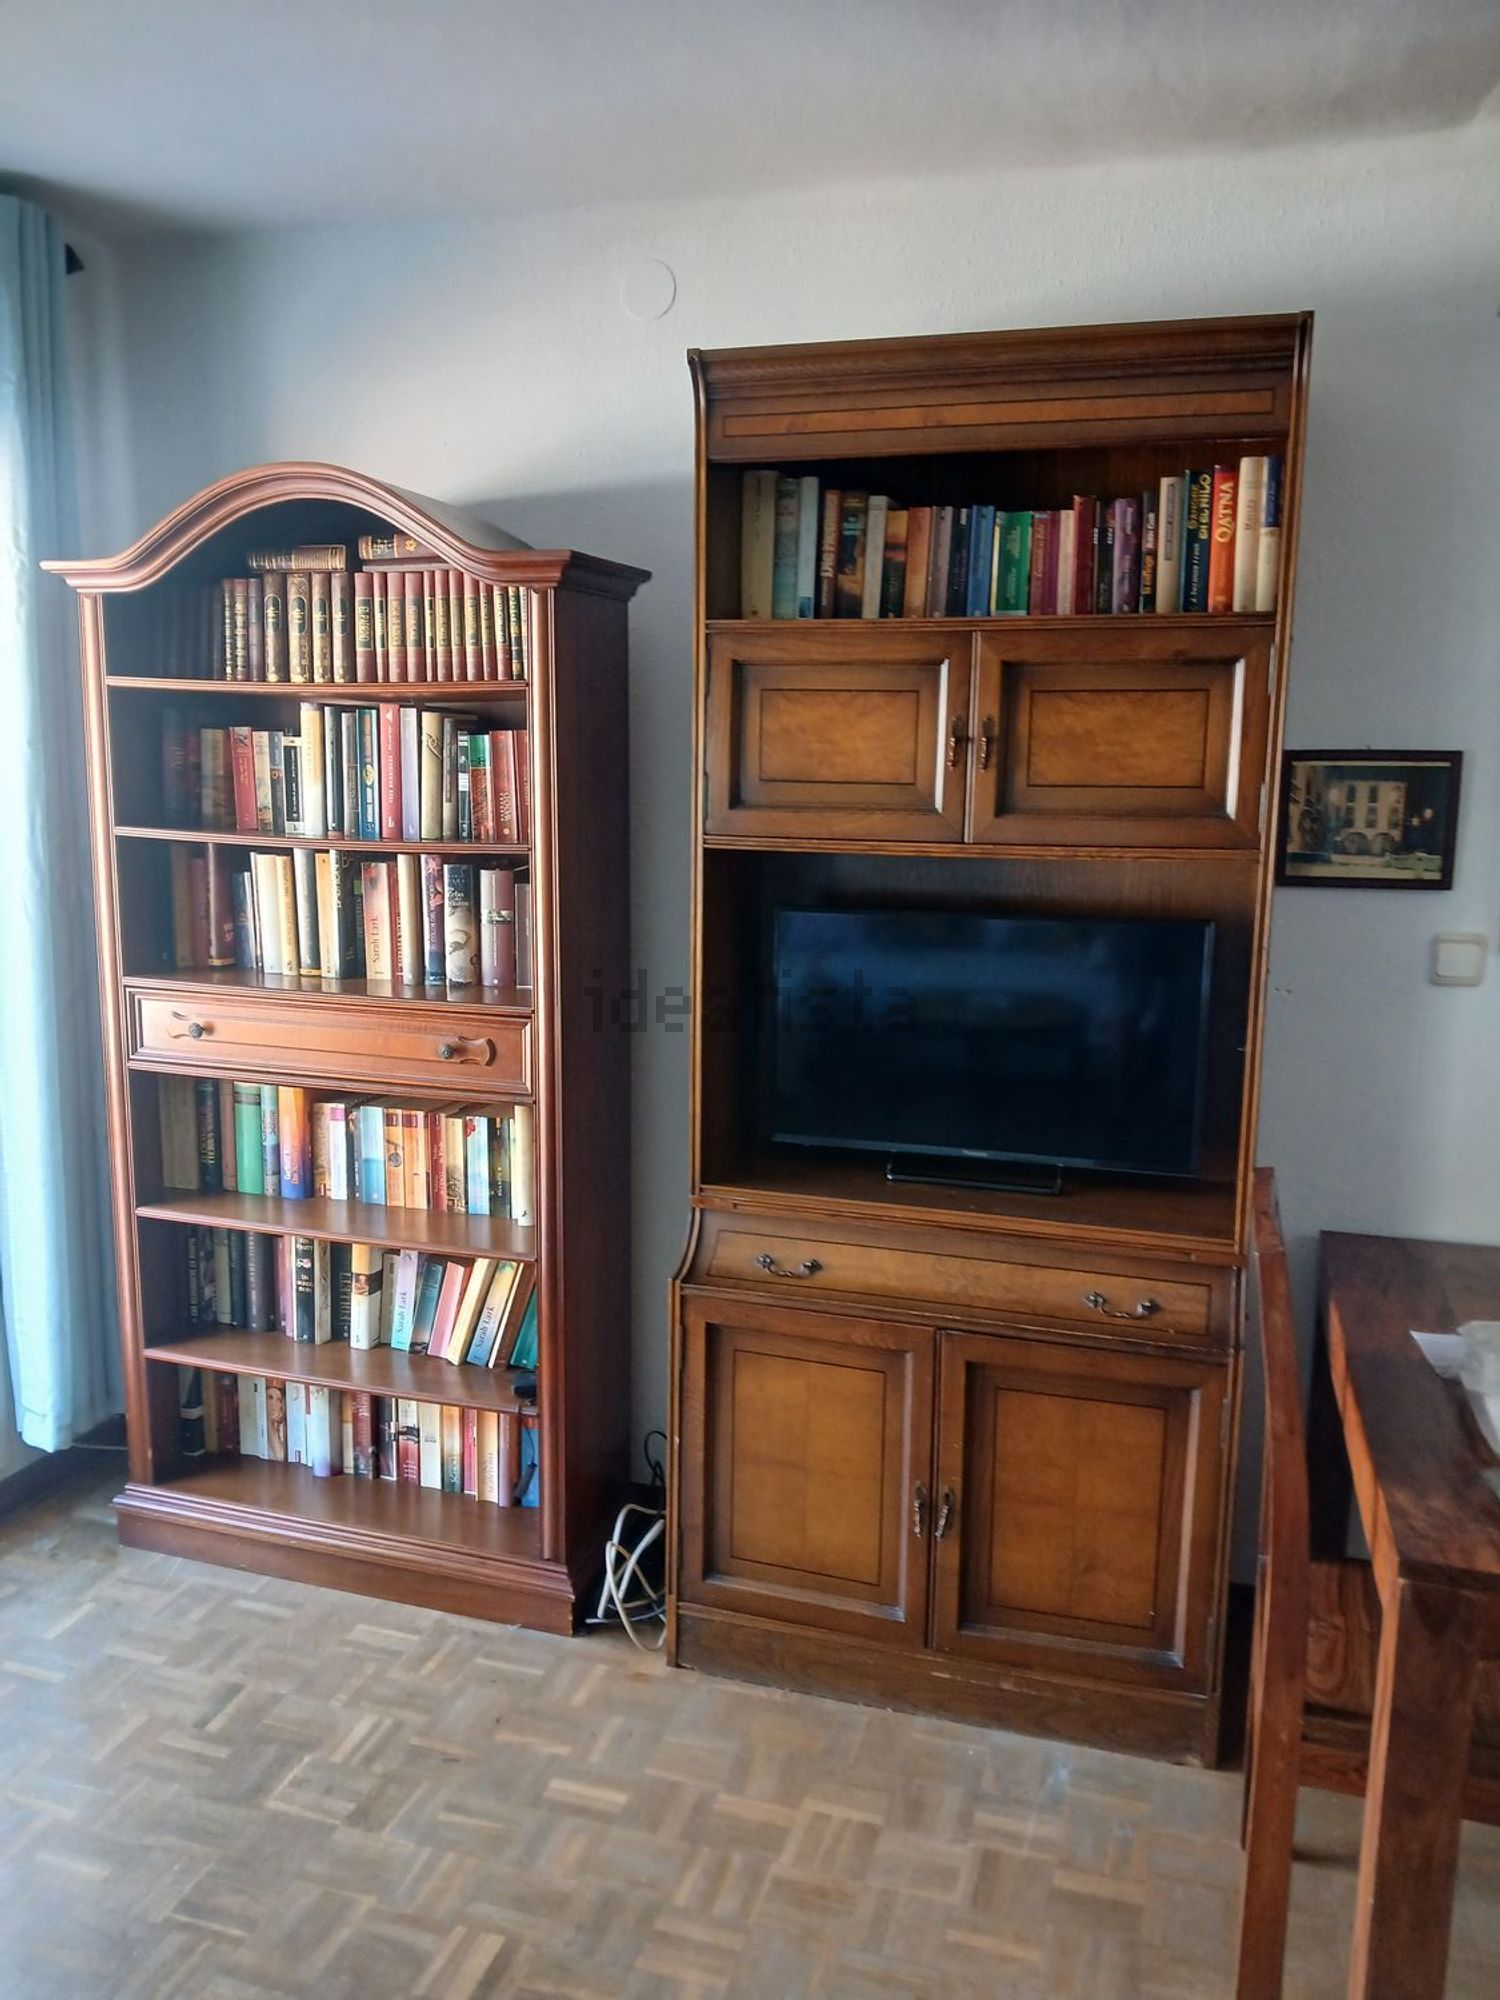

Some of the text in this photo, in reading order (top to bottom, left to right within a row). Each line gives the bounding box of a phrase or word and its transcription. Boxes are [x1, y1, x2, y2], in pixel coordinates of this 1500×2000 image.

[1199, 473, 1212, 508] NILO
[1214, 481, 1236, 543] QATNA
[369, 915, 381, 963] Sarah Lark
[397, 1291, 408, 1333] Sarah Lark
[474, 1305, 496, 1349] Sarah Lark
